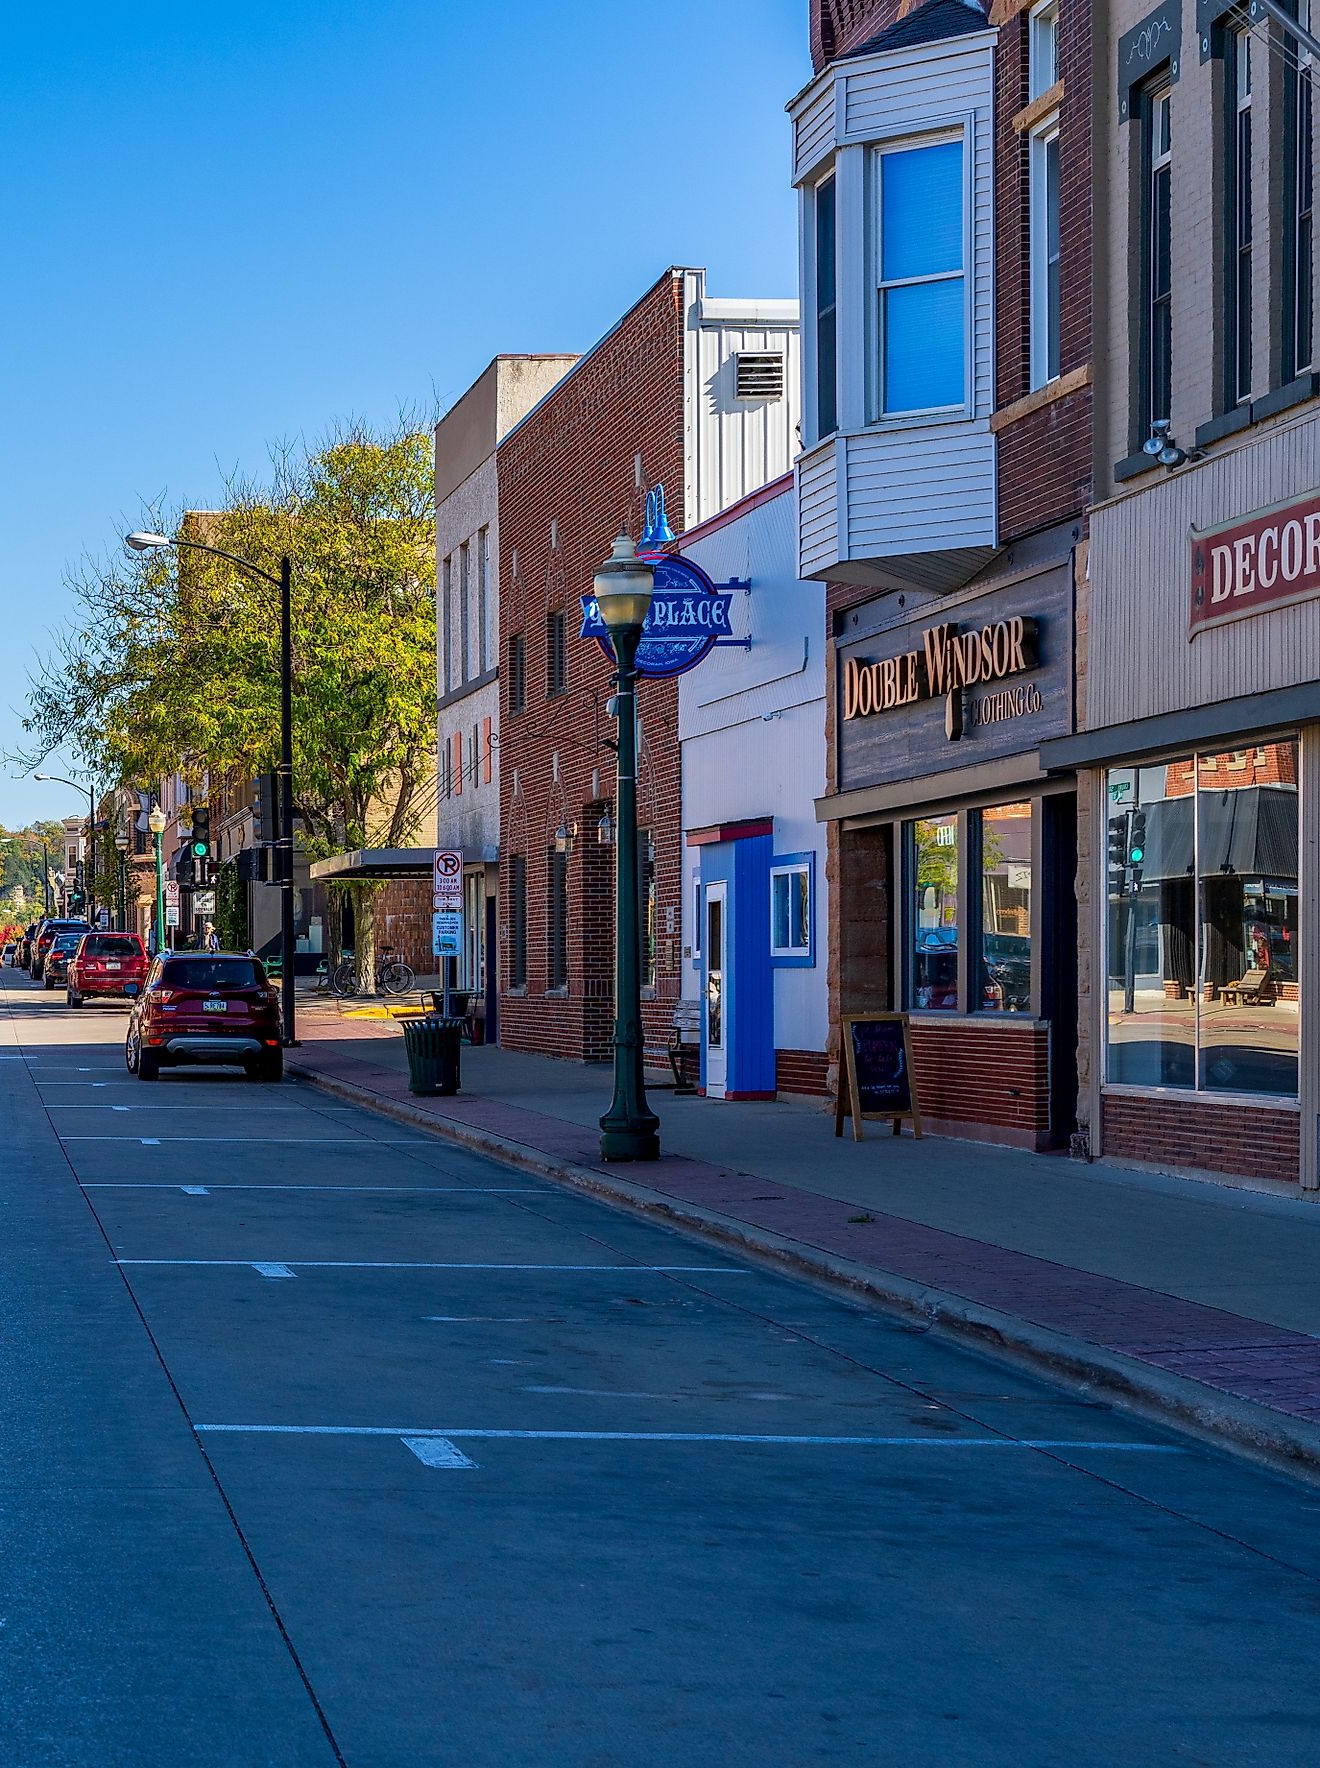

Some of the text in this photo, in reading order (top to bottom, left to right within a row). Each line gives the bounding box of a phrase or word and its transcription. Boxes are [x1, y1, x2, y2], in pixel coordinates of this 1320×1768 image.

[653, 598, 727, 628] PLACE
[844, 650, 919, 721] DOUBLE
[970, 686, 1024, 728] CLOTHING
